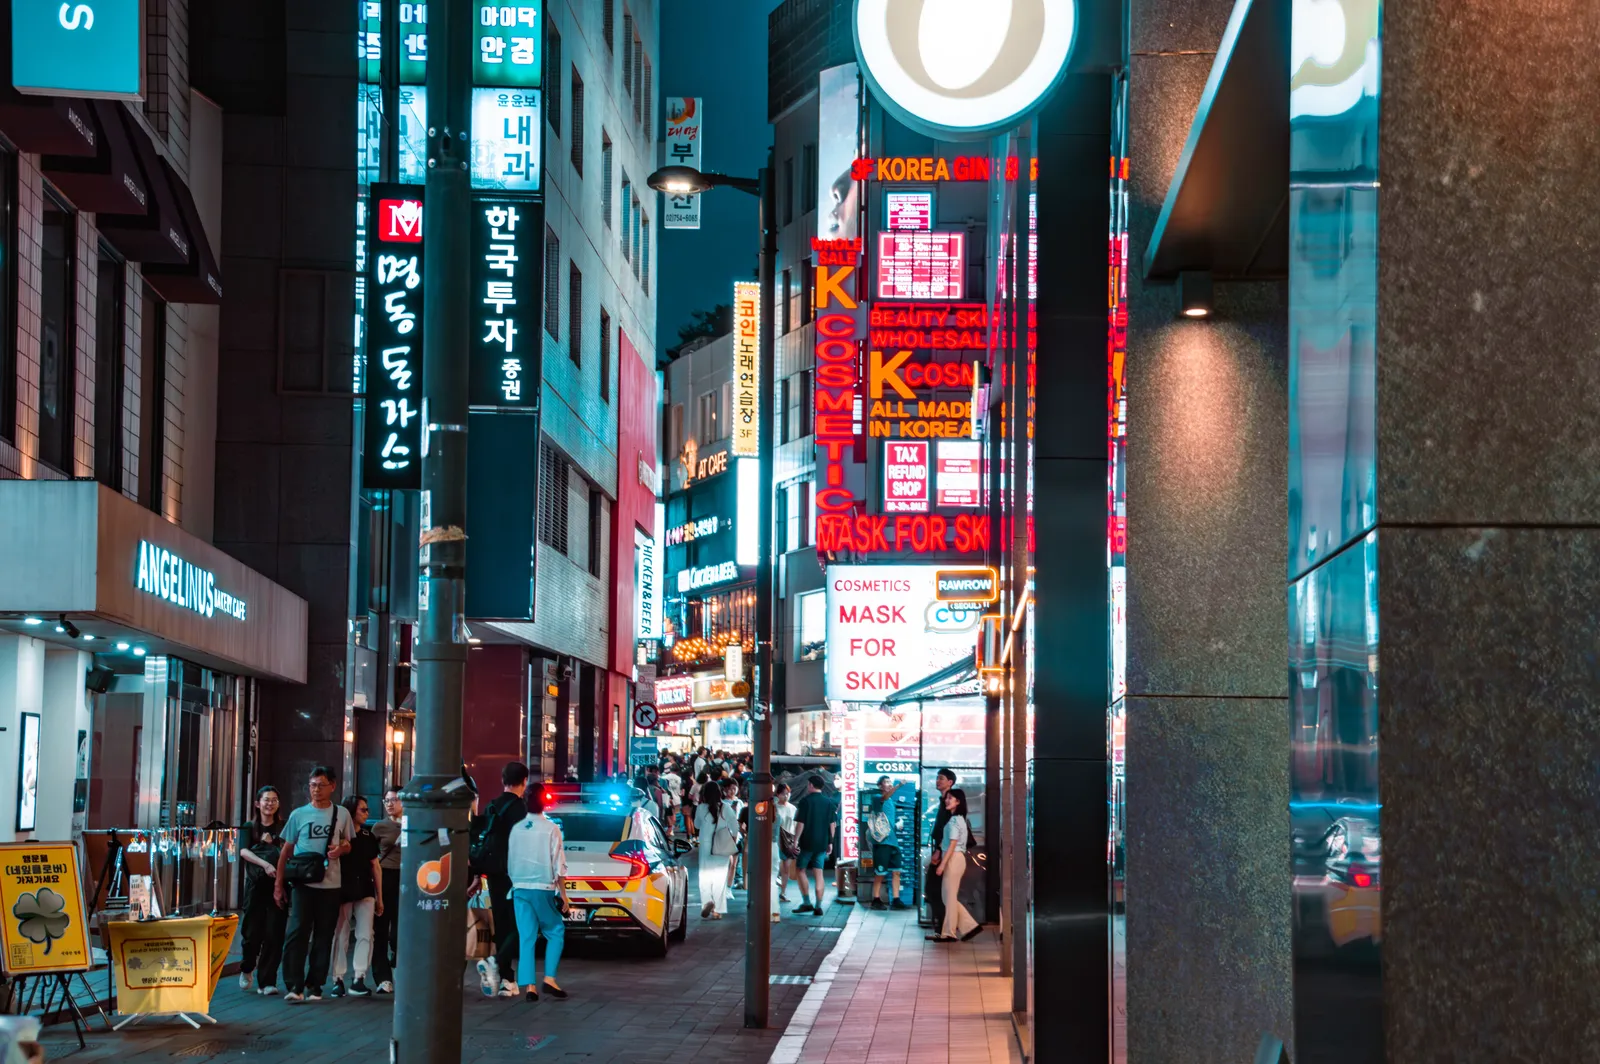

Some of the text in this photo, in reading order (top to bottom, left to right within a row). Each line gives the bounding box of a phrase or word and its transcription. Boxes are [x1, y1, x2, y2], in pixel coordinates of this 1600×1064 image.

[481, 5, 537, 27] 아이닥
[480, 36, 534, 64] 안경
[502, 115, 535, 181] 내과
[671, 143, 694, 209] 부산
[877, 157, 950, 181] KOREA
[953, 157, 990, 182] GIN
[811, 237, 862, 251] WHOLE
[818, 251, 857, 265] SALE
[482, 206, 520, 353] 한국투자
[501, 358, 521, 401] 증권
[870, 309, 988, 328] BEAUTY SKI
[870, 330, 987, 349] WHOLESAL
[739, 299, 755, 424] 코인노래연습장
[870, 351, 974, 399] K COSM
[815, 265, 858, 512] K COSMETIC
[870, 401, 910, 419] ALL
[870, 420, 972, 438] IN KOREA
[708, 451, 727, 475] CAFE
[894, 446, 919, 463] TAX
[888, 464, 926, 480] REFUND
[892, 481, 922, 496] SHOP
[816, 513, 990, 552] MASK FOR SK
[138, 540, 215, 618] ANGELINUS
[233, 597, 246, 621] CAFE
[834, 580, 911, 592] COSMETICS
[938, 579, 992, 591] RAWROW
[839, 605, 907, 623] MASK
[850, 638, 897, 656] FOR
[845, 671, 900, 690] SKIN
[876, 763, 912, 772] COSRX
[844, 753, 856, 834] COSMETICS
[16, 874, 60, 884] 가져가세요
[416, 899, 449, 910] 서울중구
